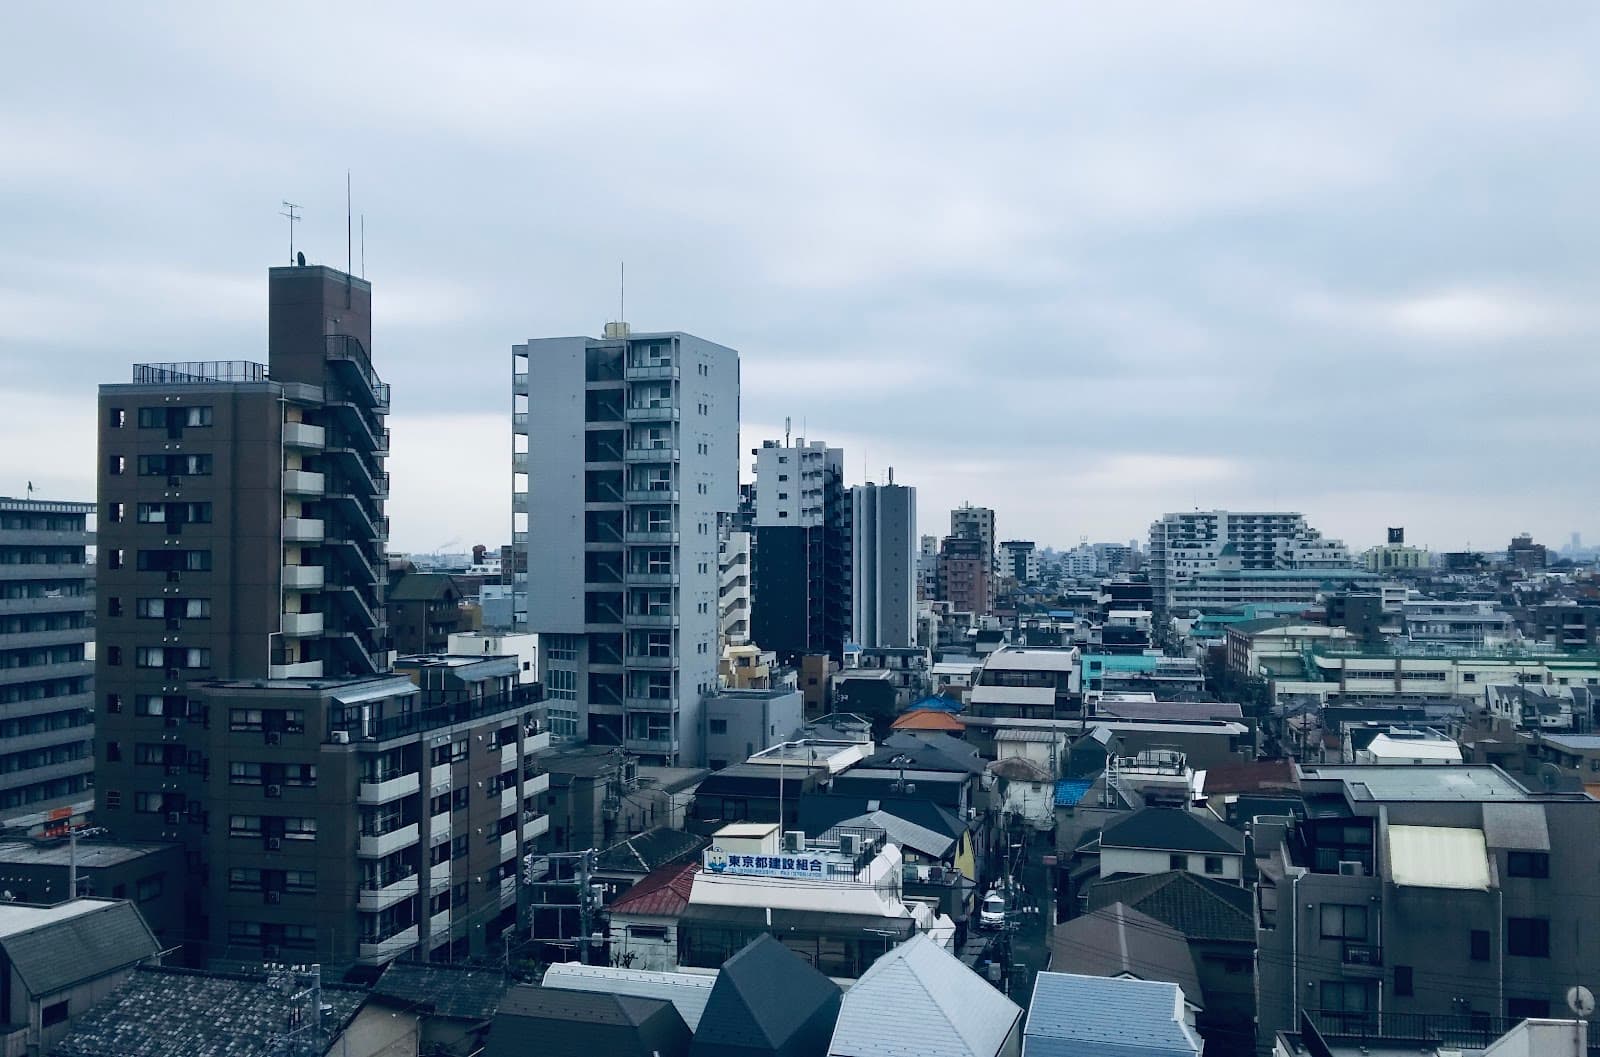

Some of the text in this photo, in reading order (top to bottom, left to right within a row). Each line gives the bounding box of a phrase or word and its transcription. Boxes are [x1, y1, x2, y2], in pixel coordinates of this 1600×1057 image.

[728, 855, 822, 872] 東京都建設組合
